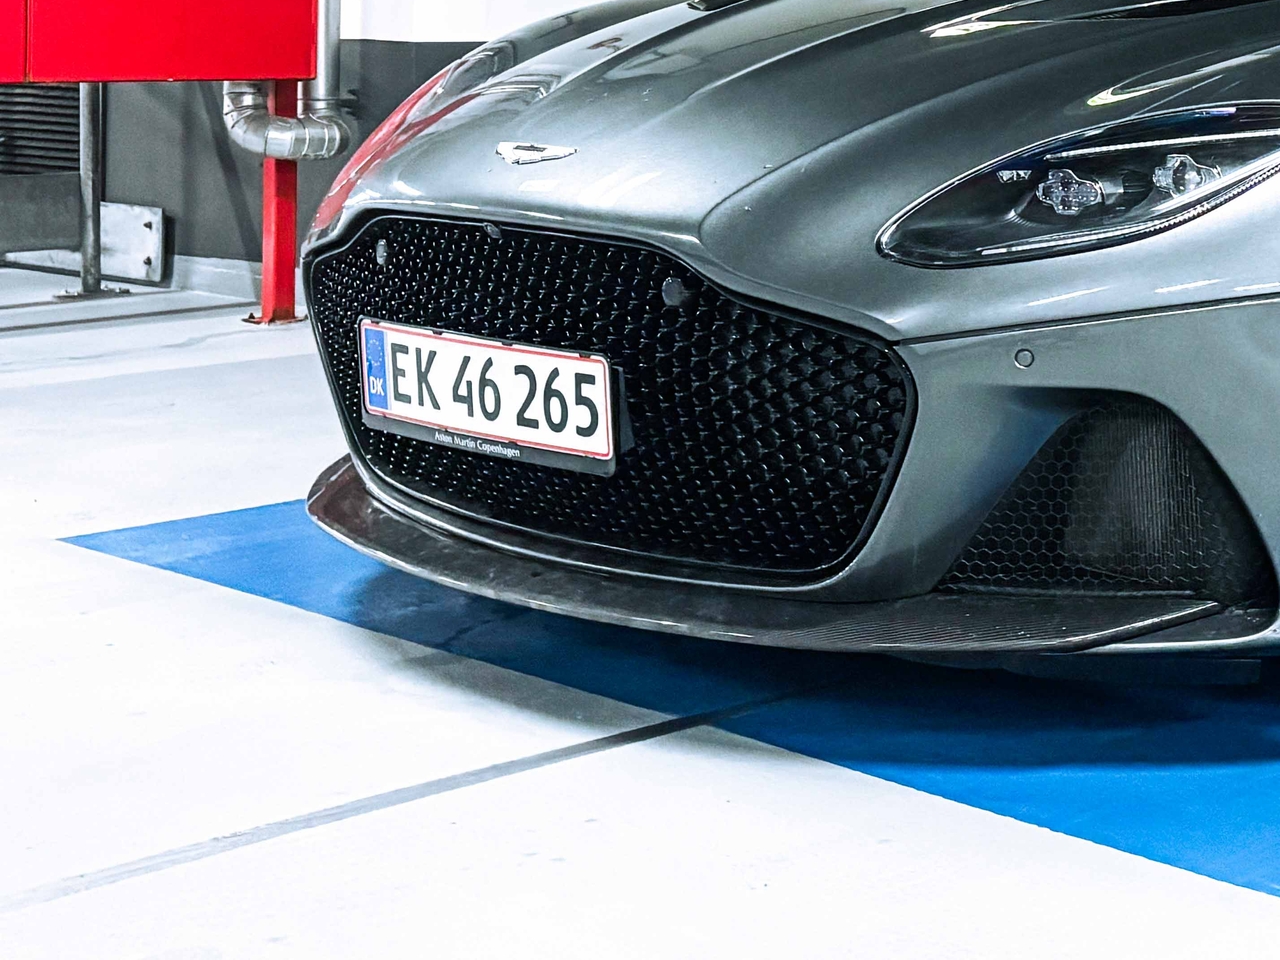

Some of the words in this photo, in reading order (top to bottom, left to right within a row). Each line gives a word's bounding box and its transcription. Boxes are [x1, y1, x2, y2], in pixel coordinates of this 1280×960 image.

[369, 376, 385, 396] DK
[390, 342, 441, 411] EK
[452, 355, 502, 422] 46
[514, 364, 599, 438] 265
[434, 431, 453, 445] Aston
[453, 435, 476, 449] Martin
[476, 440, 521, 458] Copenhagen
